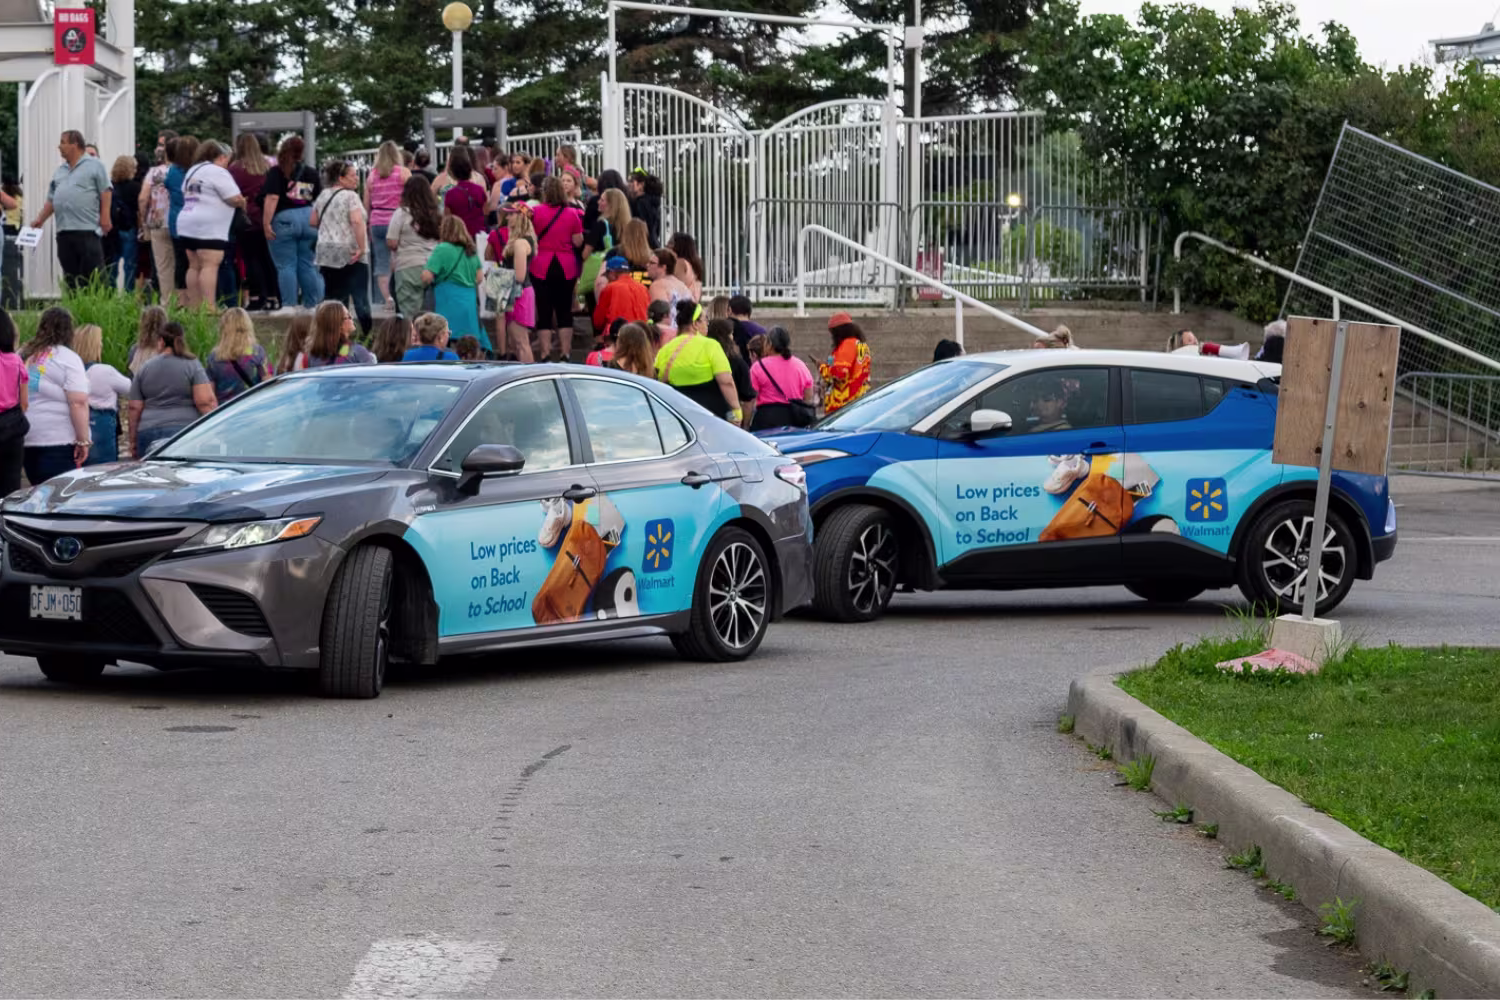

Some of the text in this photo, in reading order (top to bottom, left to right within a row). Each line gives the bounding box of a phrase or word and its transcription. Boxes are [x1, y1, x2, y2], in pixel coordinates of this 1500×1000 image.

[956, 482, 1040, 503] Low prices
[956, 506, 1018, 522] on Back
[956, 528, 1030, 544] to School
[1182, 525, 1230, 537] Walmart
[470, 537, 537, 562] Low prices
[471, 566, 521, 589] on Back
[637, 575, 675, 591] Walmart
[468, 592, 527, 618] to School
